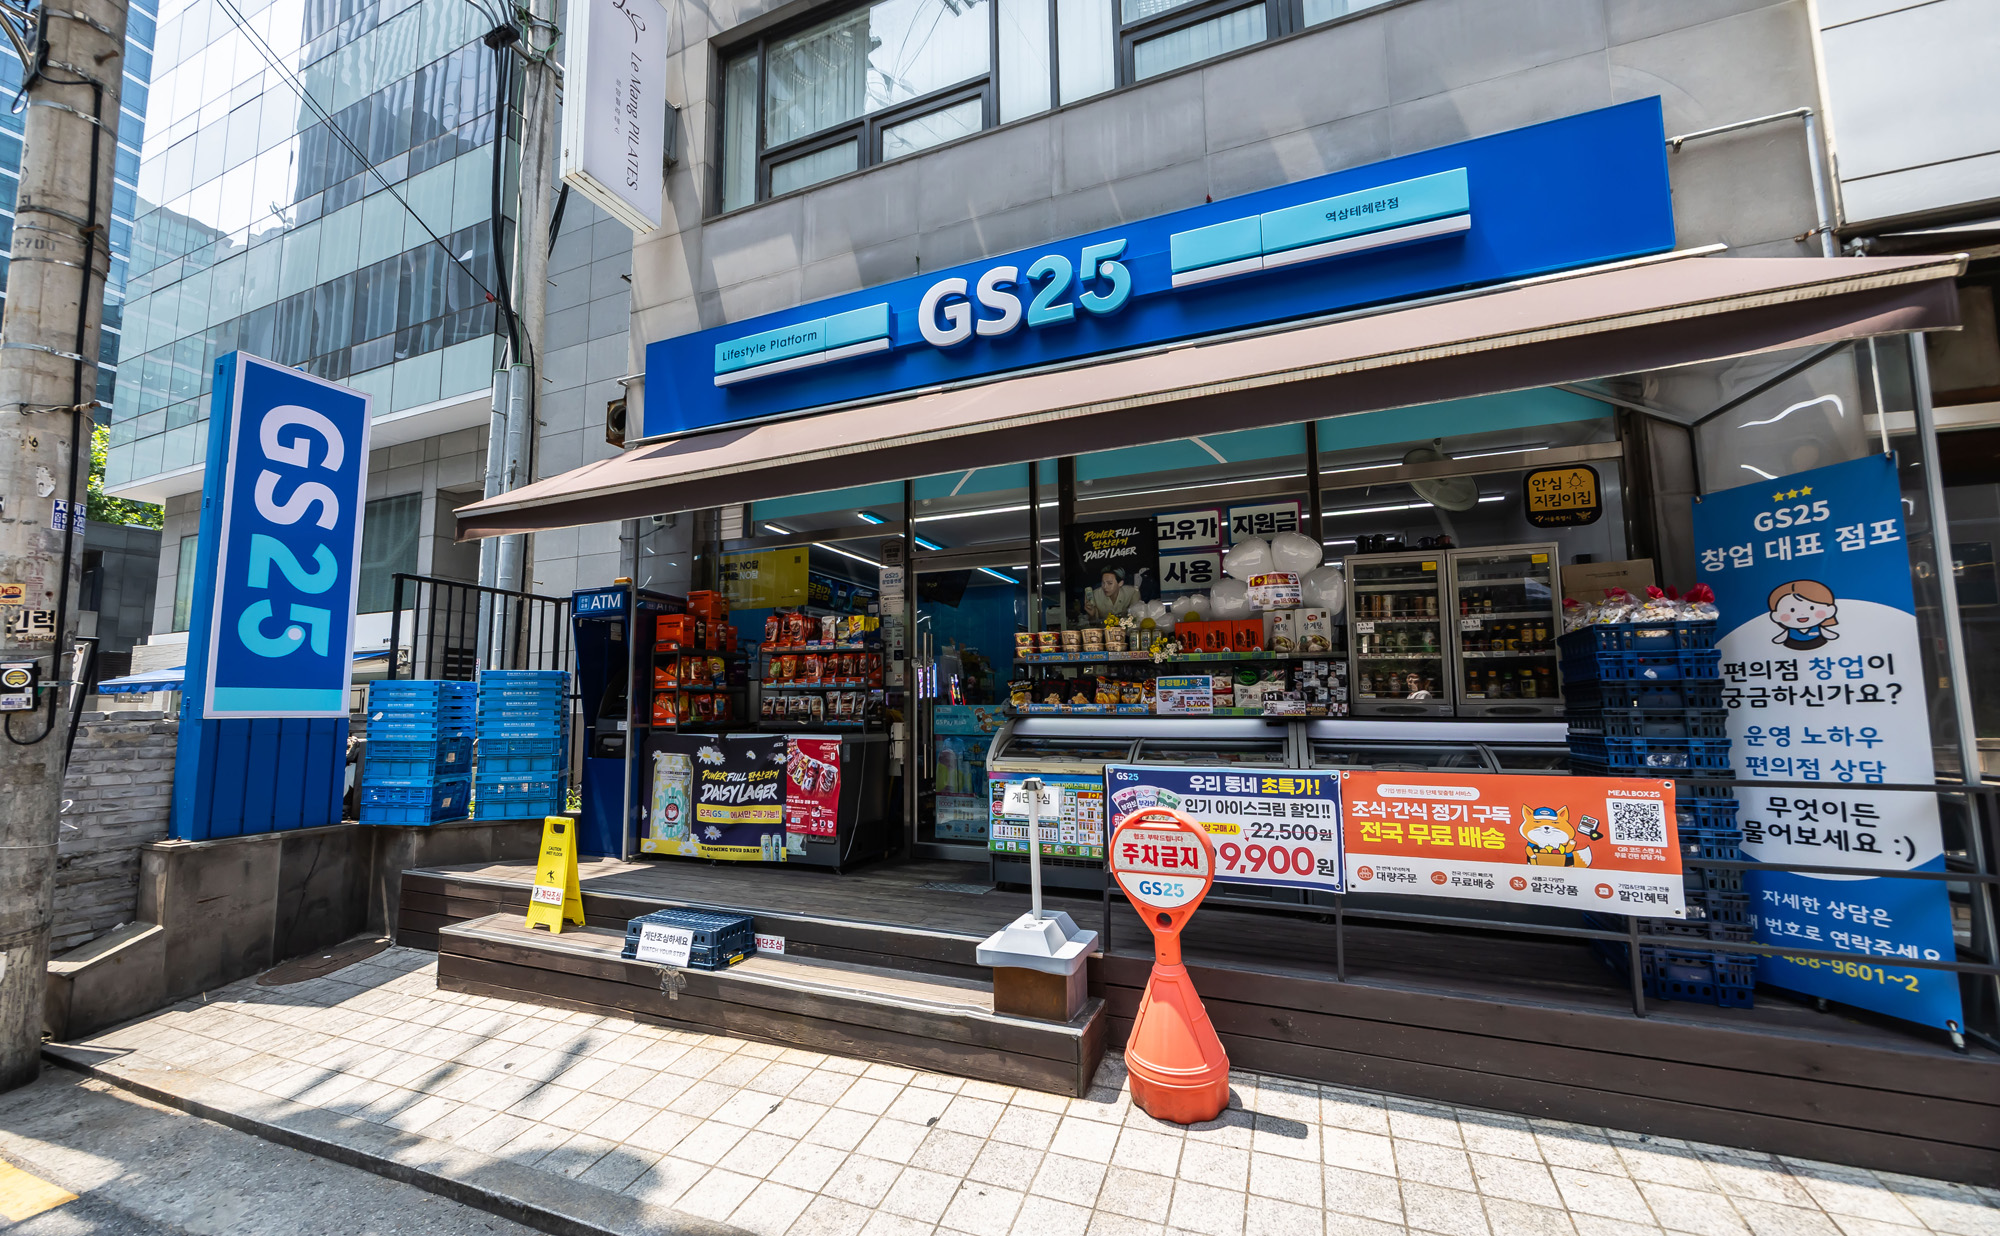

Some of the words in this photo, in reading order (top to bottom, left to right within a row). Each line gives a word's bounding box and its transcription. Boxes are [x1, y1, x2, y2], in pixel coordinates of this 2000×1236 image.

[631, 51, 642, 72] Le
[626, 75, 642, 117] Mang
[627, 120, 640, 191] PILATES
[1325, 197, 1400, 223] 역삼테헤란점
[917, 238, 1132, 347] GS25
[721, 342, 767, 362] Lifestyle
[769, 329, 818, 352] Platform
[1532, 476, 1562, 492] 안심
[1535, 490, 1590, 507] 지킴이집
[1233, 511, 1297, 535] 지원금
[1754, 500, 1830, 532] GS25
[238, 404, 345, 658] GS25
[1084, 526, 1140, 542] POWERFULL
[1158, 517, 1217, 541] 고유가
[1701, 543, 1754, 572] 창업
[1765, 532, 1824, 561] 대표
[1835, 518, 1900, 552] 점포
[1164, 560, 1213, 584] 사용
[1250, 575, 1268, 586] 1+1
[591, 593, 621, 610] ATM
[1724, 659, 1798, 682] 편의점
[1808, 653, 1894, 681] 창업이
[1264, 693, 1277, 701] 1+1
[1721, 683, 1902, 708] 궁금하신가요?
[1744, 726, 1791, 748] 운영
[1801, 726, 1884, 748] 노하우
[1116, 772, 1139, 781] GS25
[1745, 756, 1820, 780] 편의점
[1830, 760, 1886, 783] 상담
[1189, 775, 1220, 792] 우리
[1225, 777, 1258, 794] 동네
[1261, 778, 1320, 795] 초특가!
[1607, 789, 1661, 798] MEALBOX25
[700, 809, 711, 817] 오직
[752, 810, 763, 818] 구매
[763, 810, 780, 819] 가능!!
[1120, 800, 1137, 811] 부라보
[1185, 799, 1213, 815] 인기
[1215, 800, 1286, 818] 아이스크림
[1290, 802, 1330, 819] 할인!!
[1351, 800, 1428, 820] 조식·간식
[1431, 803, 1468, 823] 정기
[1472, 805, 1511, 824] 구독
[1766, 796, 1880, 829] 무엇이든
[1147, 833, 1183, 843] 부탁드립니다
[1212, 824, 1227, 833] 구매
[1229, 825, 1237, 833] 시
[1250, 821, 1332, 842] 22,500원
[1360, 821, 1403, 845] 전국
[1408, 823, 1455, 846] 무료
[1457, 826, 1506, 850] 배송
[1742, 820, 1883, 854] 물어보세요
[1122, 842, 1199, 869] 주차금지
[1640, 853, 1653, 861] 상담
[1653, 854, 1666, 862] 가능
[1376, 872, 1417, 884] 대량주문
[1451, 877, 1495, 890] 무료배송
[1618, 883, 1646, 891] 기업&단체
[1647, 884, 1658, 892] 고객
[542, 890, 562, 901] 계단조심
[1139, 881, 1185, 898] GS25
[1530, 882, 1579, 897] 알찬상품
[1618, 890, 1669, 905] 할인혜택
[1762, 890, 1821, 915] 자세한
[1827, 901, 1893, 927] 상담은
[643, 931, 689, 946] 계단조심하세요
[755, 937, 783, 950] 계단조심
[1765, 917, 1824, 942] 번호로
[1829, 931, 1941, 961] 연락주세요
[641, 945, 660, 954] WATCH
[659, 947, 673, 956] YOUR
[673, 949, 686, 958] STEP
